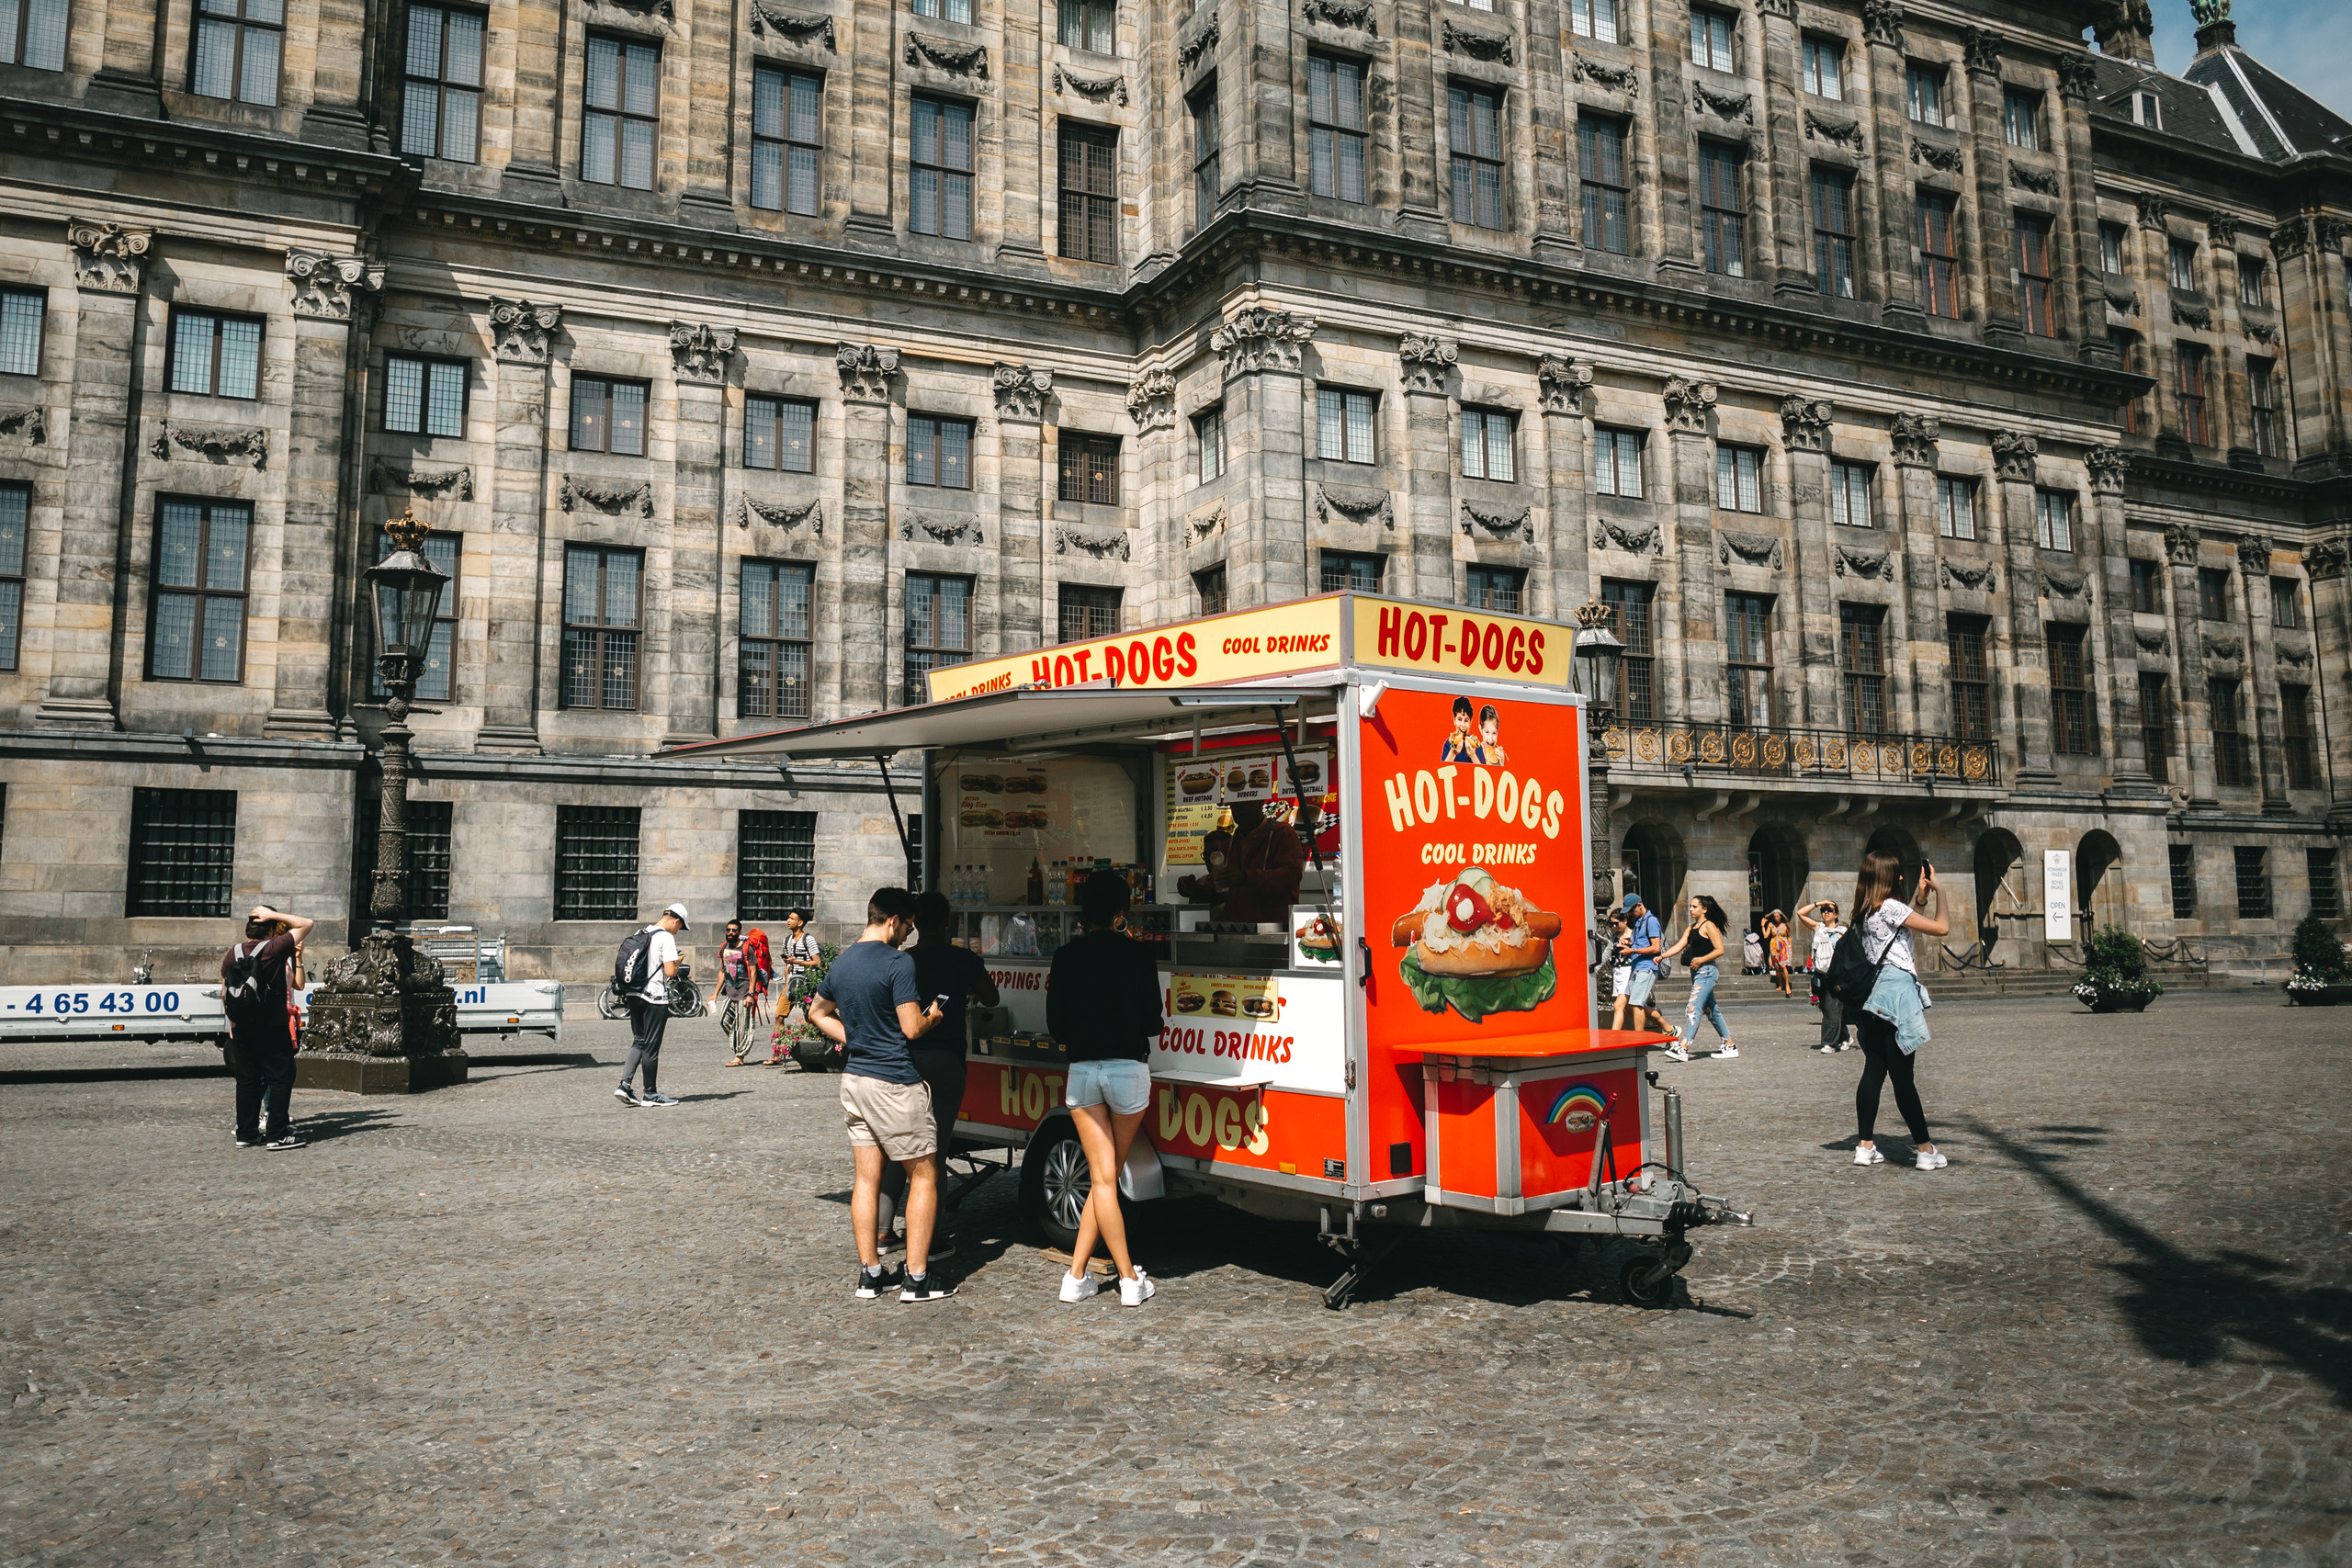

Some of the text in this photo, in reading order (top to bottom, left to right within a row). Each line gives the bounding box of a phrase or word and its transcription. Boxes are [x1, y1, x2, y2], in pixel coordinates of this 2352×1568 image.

[1032, 631, 1197, 690] HOT-DOGS
[1223, 634, 1330, 654] COOL DRINKS
[1378, 607, 1544, 674] HOT-DOGS
[1385, 765, 1564, 840] HOT-DOGS
[1421, 843, 1537, 865] COOL DRINKS
[26, 994, 43, 1013] 4
[54, 993, 89, 1013] 65
[99, 993, 134, 1012] 43
[145, 992, 179, 1012] 00
[1159, 1026, 1294, 1064] COOL DRINKS
[1159, 1089, 1269, 1156] DOGS
